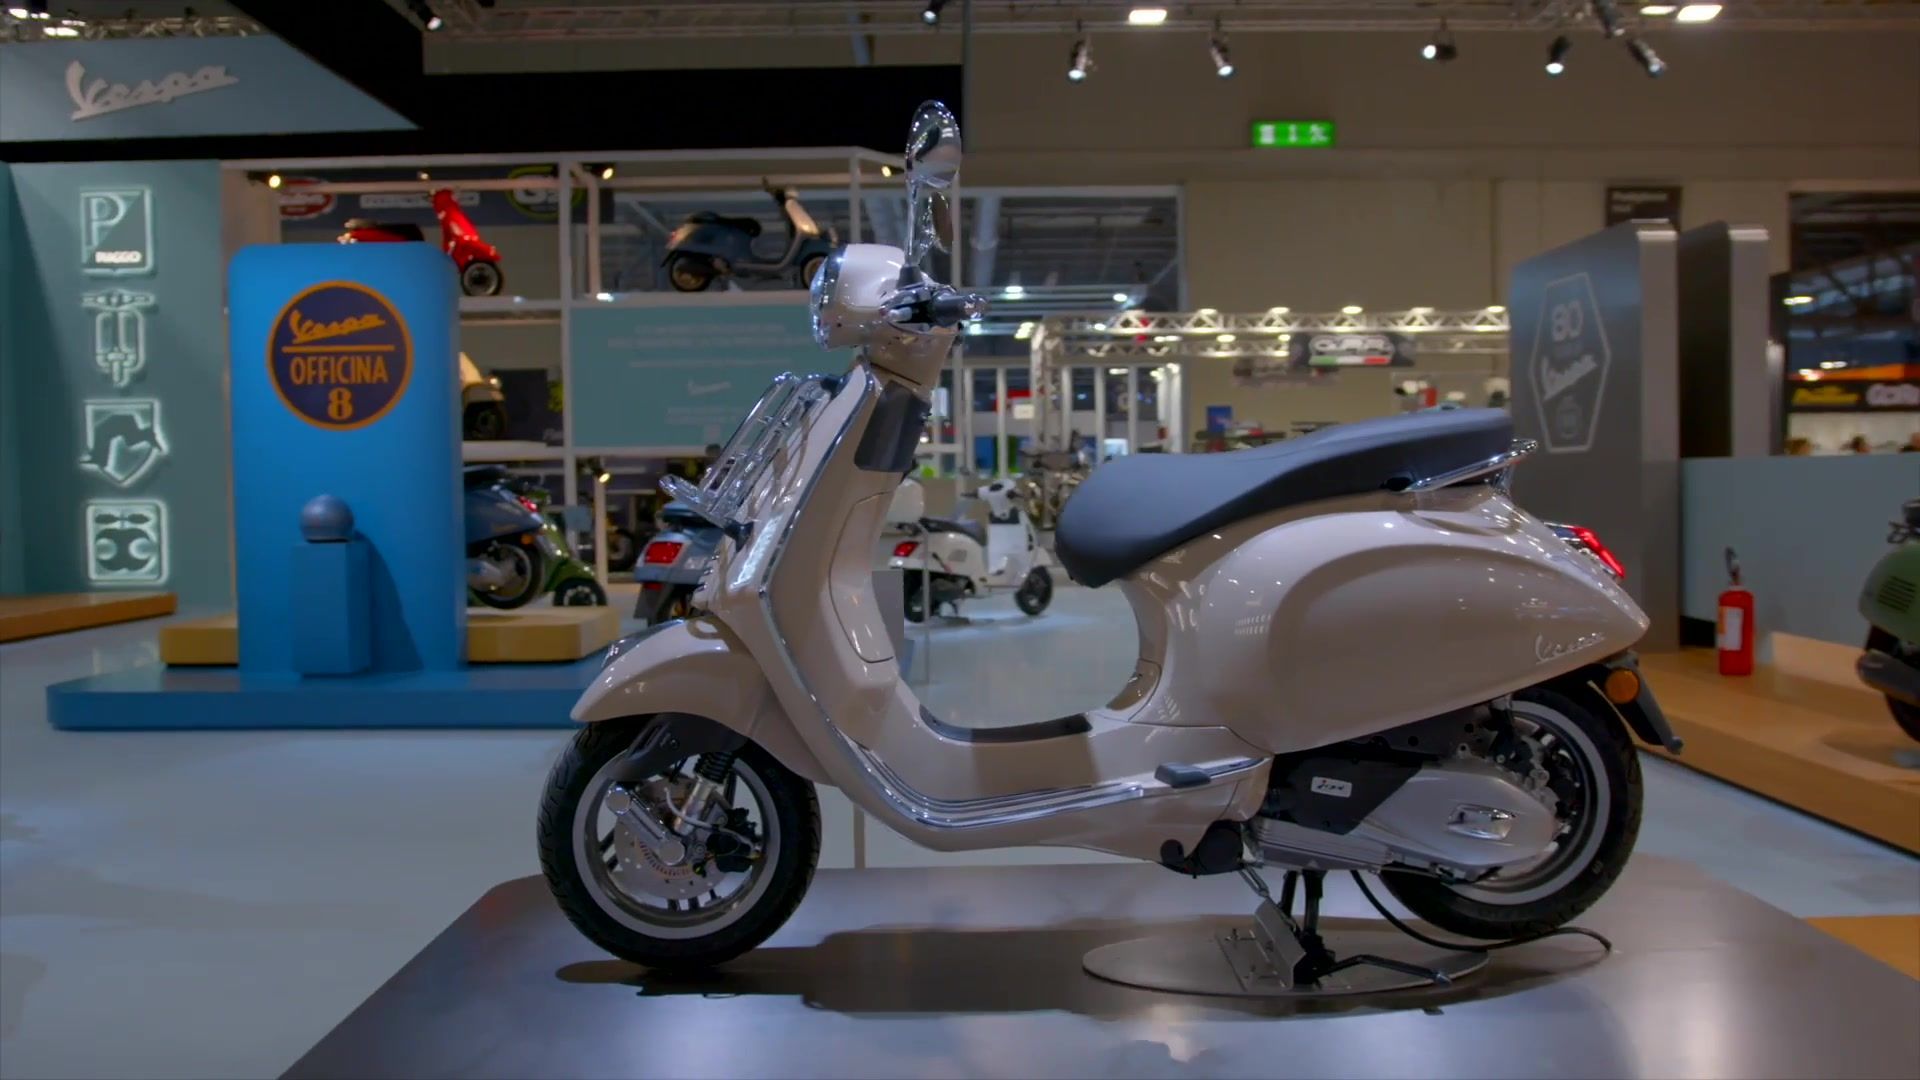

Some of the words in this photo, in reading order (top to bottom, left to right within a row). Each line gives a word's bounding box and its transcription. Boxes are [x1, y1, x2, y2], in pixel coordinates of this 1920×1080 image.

[65, 60, 239, 121] Vespa
[290, 309, 386, 344] Vespa
[1551, 300, 1583, 342] 80
[290, 355, 389, 385] OFFICINA
[328, 387, 353, 420] 8
[1535, 632, 1605, 665] Vespa
